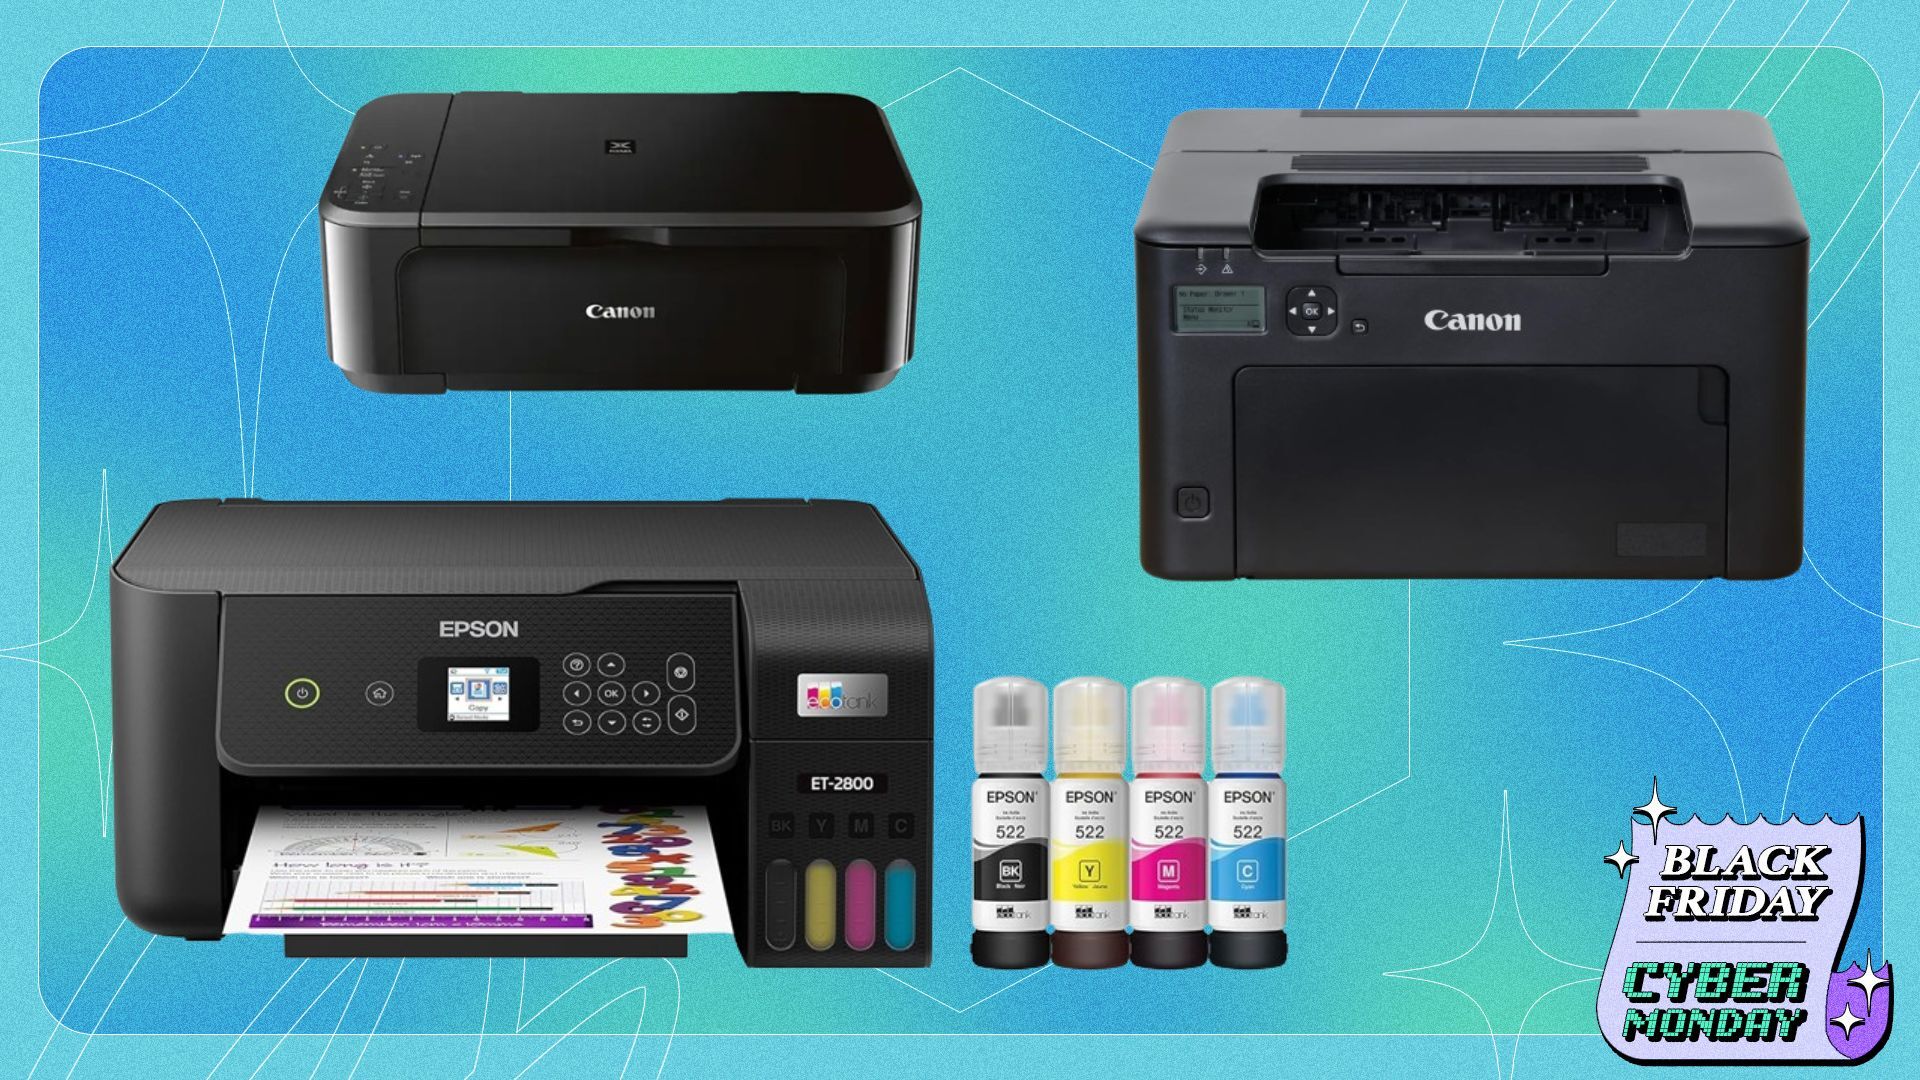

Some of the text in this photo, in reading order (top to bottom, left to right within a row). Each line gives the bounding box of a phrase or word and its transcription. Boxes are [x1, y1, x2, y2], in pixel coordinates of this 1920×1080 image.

[585, 304, 656, 319] Canon
[1305, 308, 1319, 316] OK
[1424, 309, 1522, 331] Canon
[439, 620, 519, 638] EPSON
[604, 689, 619, 698] OK
[806, 690, 879, 710] ecotank
[811, 776, 874, 790] ET-2800
[771, 820, 793, 832] BK
[815, 819, 827, 833] Y
[854, 819, 869, 833] M
[895, 818, 908, 833] C
[996, 825, 1025, 839] 522
[1075, 825, 1104, 839] 522
[1155, 825, 1184, 839] 522
[1233, 825, 1262, 839] 522
[1002, 865, 1020, 877] BK
[1085, 865, 1095, 877] Y
[1162, 865, 1176, 878] M
[1242, 864, 1254, 878] C
